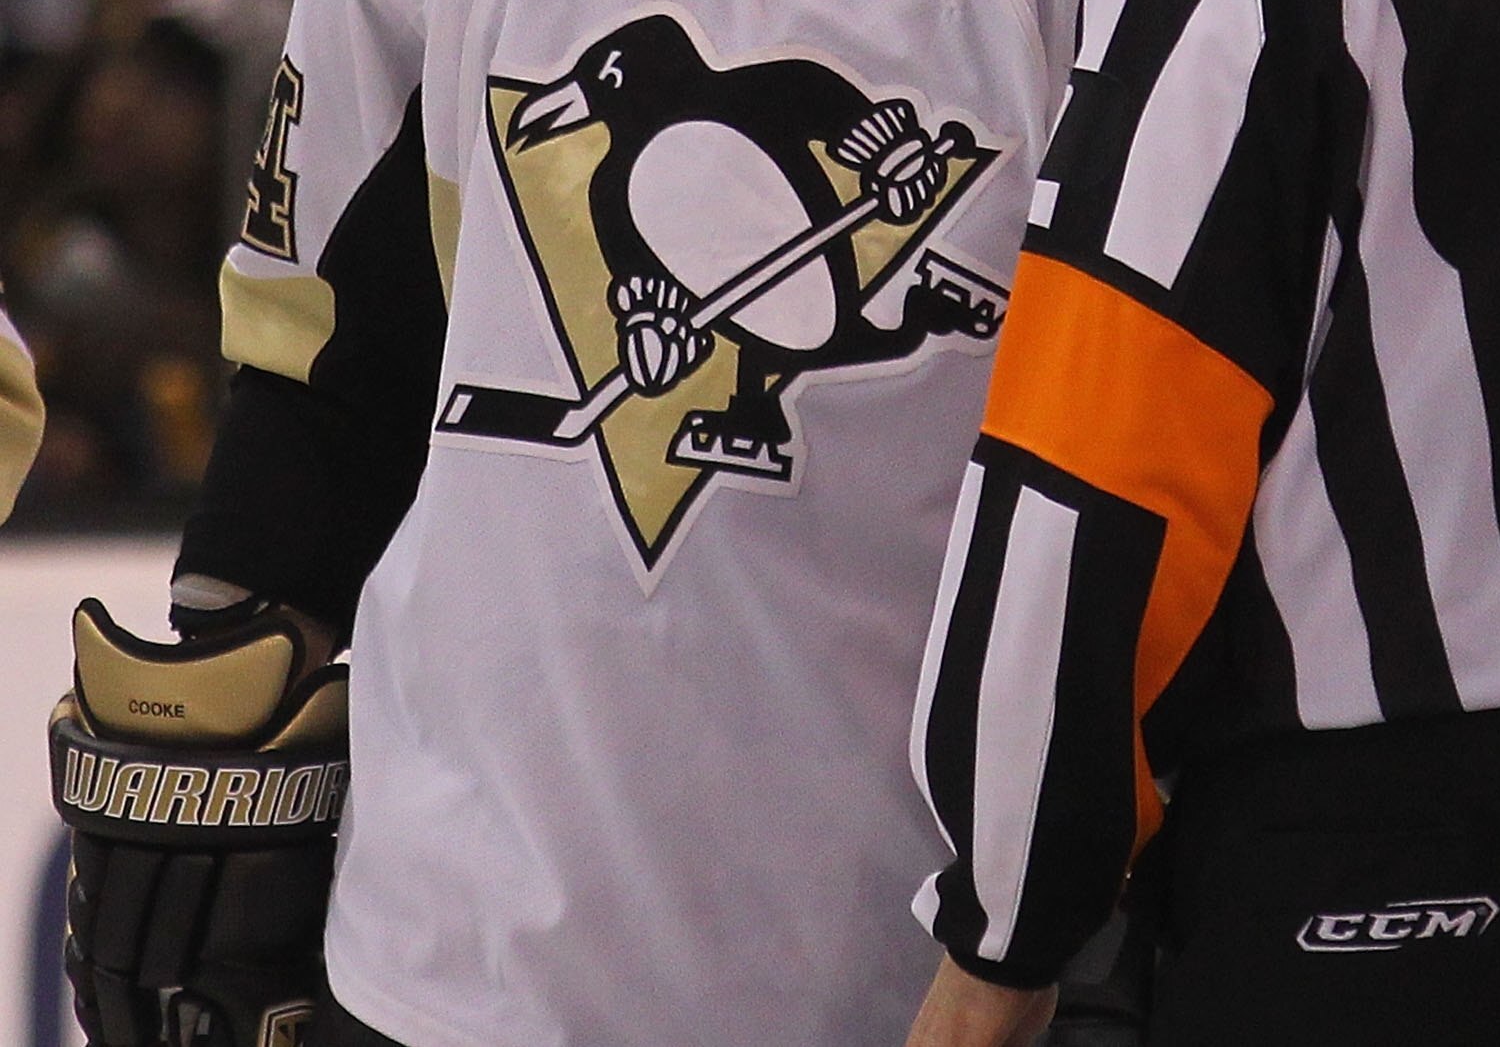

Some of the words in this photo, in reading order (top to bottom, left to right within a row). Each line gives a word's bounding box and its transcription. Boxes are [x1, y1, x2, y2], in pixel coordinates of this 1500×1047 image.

[128, 699, 185, 719] COOKE
[62, 748, 349, 827] WARRIOR
[1314, 907, 1480, 943] CCM
